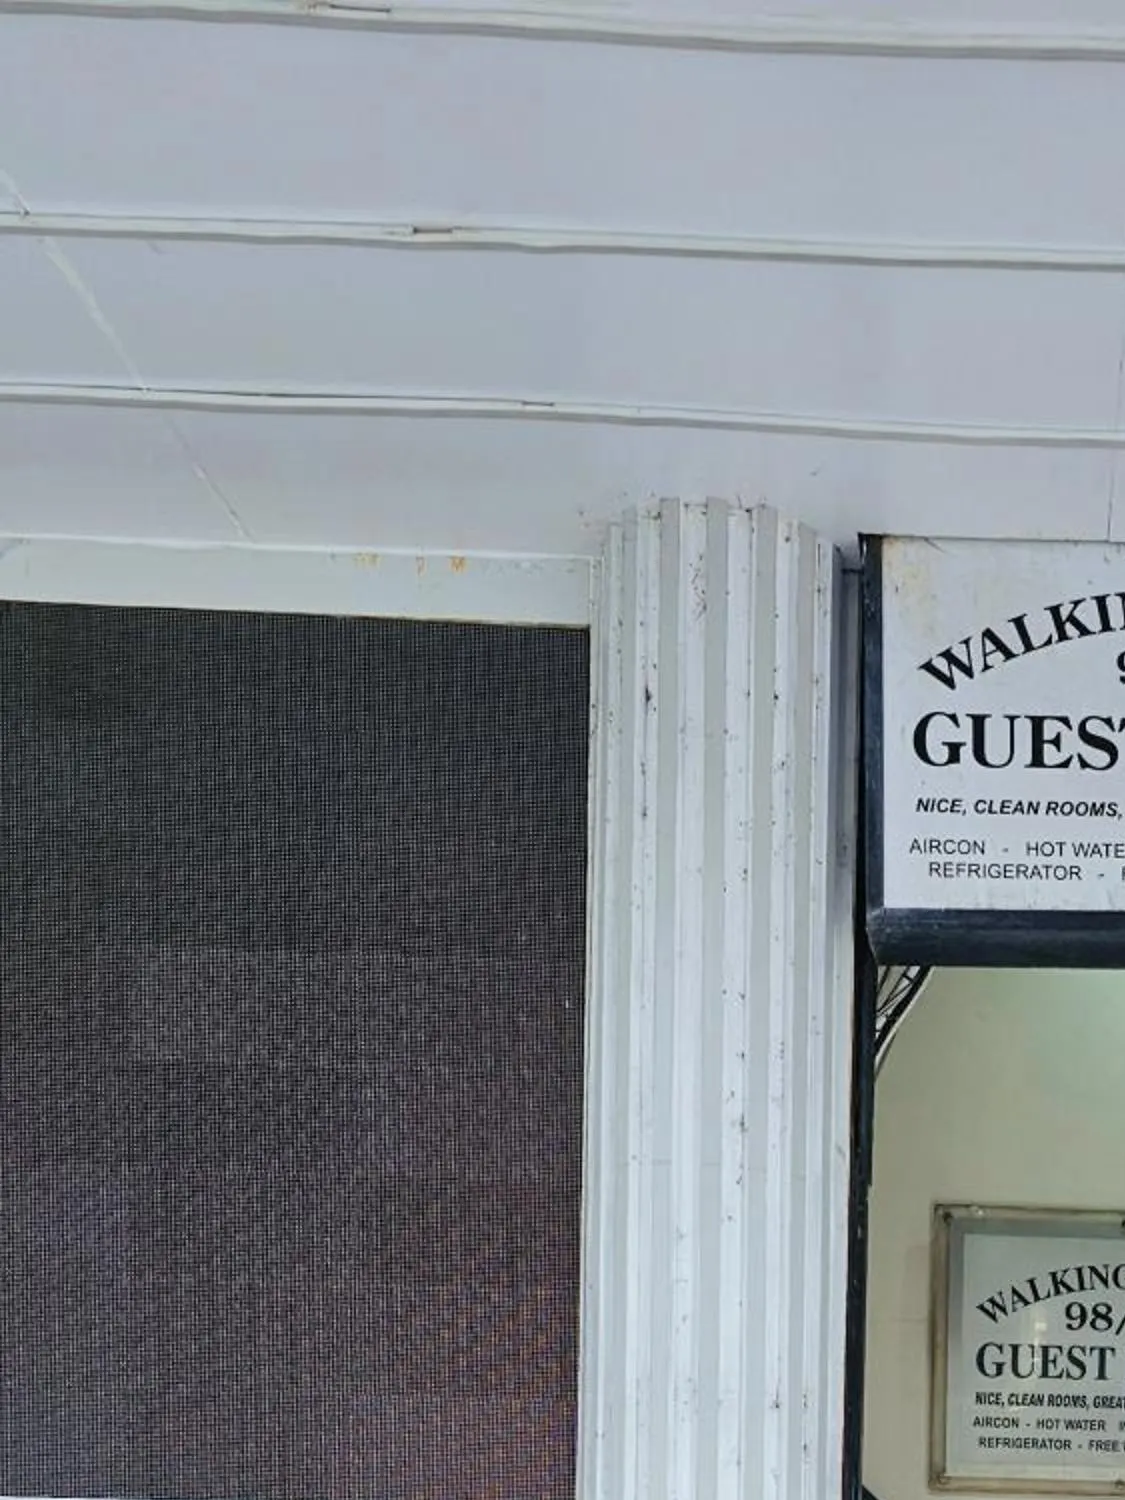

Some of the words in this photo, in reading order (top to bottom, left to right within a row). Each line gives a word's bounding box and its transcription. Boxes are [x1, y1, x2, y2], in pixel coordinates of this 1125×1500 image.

[915, 797, 968, 816] NICE,
[974, 799, 1041, 816] CLEAN
[1045, 800, 1123, 820] ROOMS,
[909, 838, 986, 856] AIRCON
[1026, 840, 1066, 858] HOT
[928, 861, 1082, 881] REFRIGERATOR
[976, 1341, 1116, 1381] GUEST
[1008, 1393, 1045, 1408] CLEAN
[973, 1416, 1020, 1429] AIRCON
[1036, 1418, 1061, 1431] HOT
[1064, 1419, 1107, 1432] WATER
[978, 1436, 1073, 1451] REFRIGERATOR
[1088, 1439, 1121, 1453] FREE
